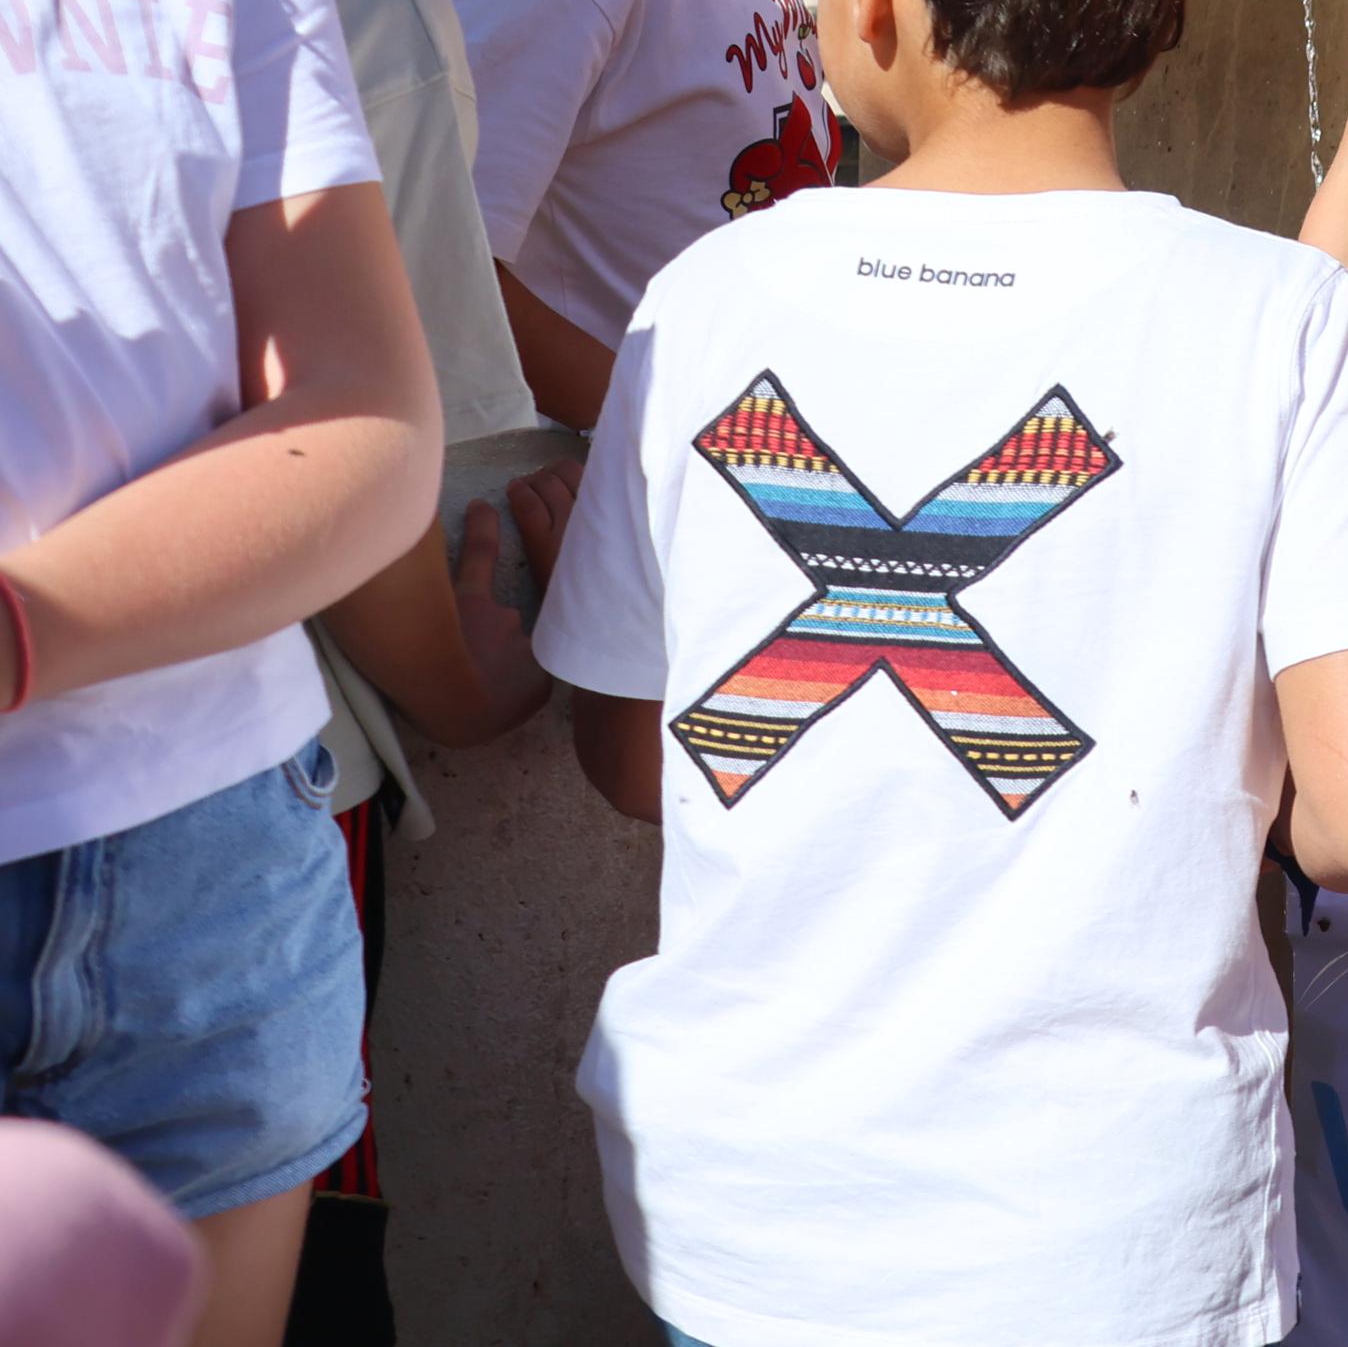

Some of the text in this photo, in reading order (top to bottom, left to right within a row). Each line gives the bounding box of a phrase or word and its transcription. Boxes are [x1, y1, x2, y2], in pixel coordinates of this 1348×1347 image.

[725, 11, 788, 94] My
[857, 257, 1016, 287] blue banana
